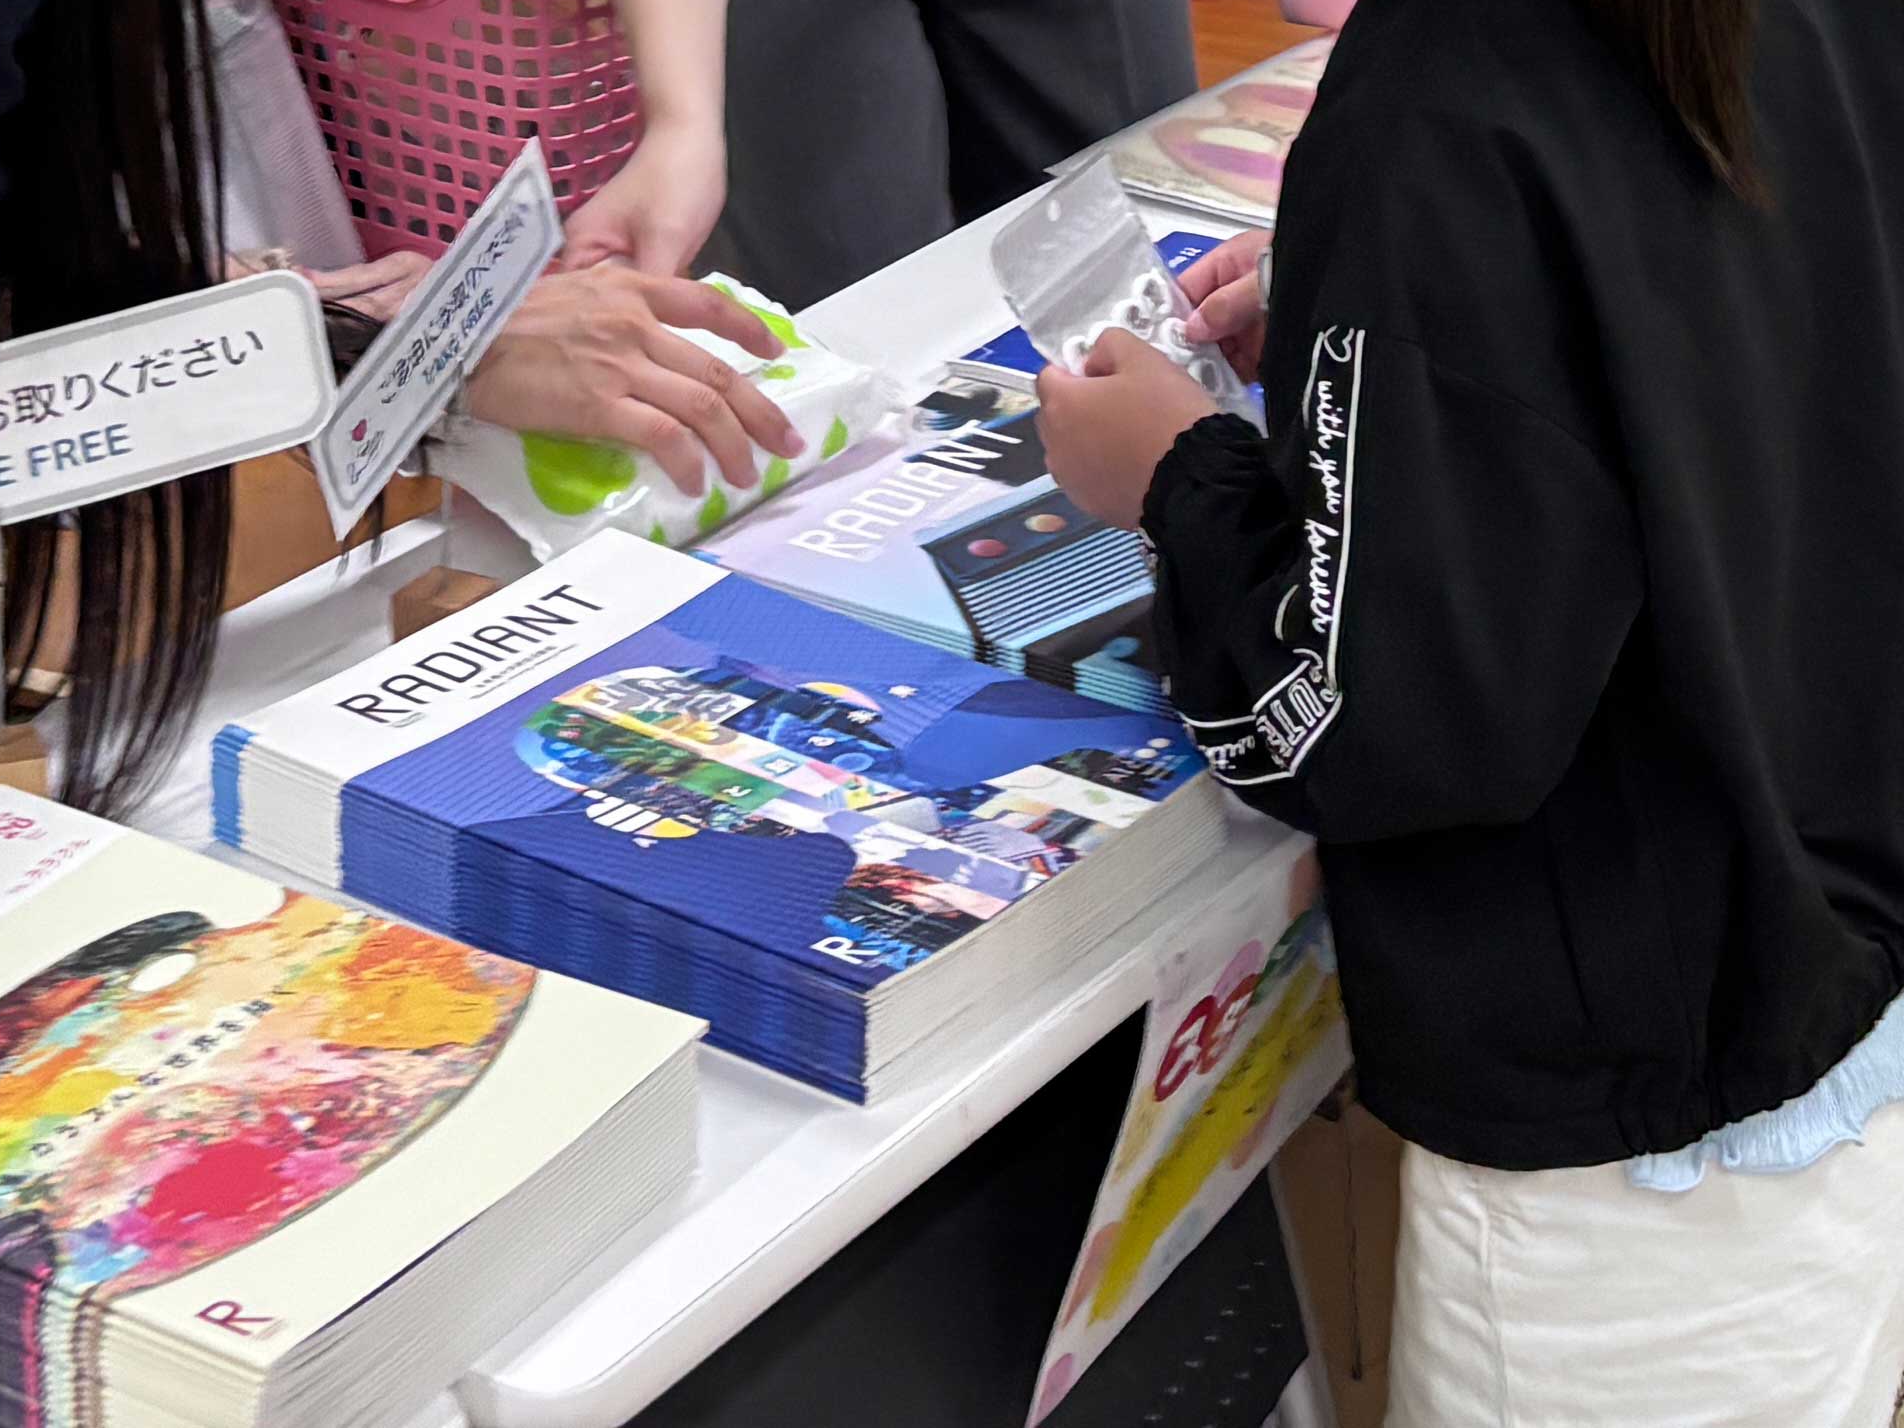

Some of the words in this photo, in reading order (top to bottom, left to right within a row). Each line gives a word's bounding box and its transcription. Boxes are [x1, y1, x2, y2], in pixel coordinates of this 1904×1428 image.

[1315, 379, 1347, 451] with
[28, 423, 134, 478] FREE
[1308, 450, 1340, 515] you
[787, 418, 1024, 562] RADIANT
[334, 584, 605, 724] RADIANT
[810, 936, 881, 965] R
[194, 1300, 274, 1336] R
